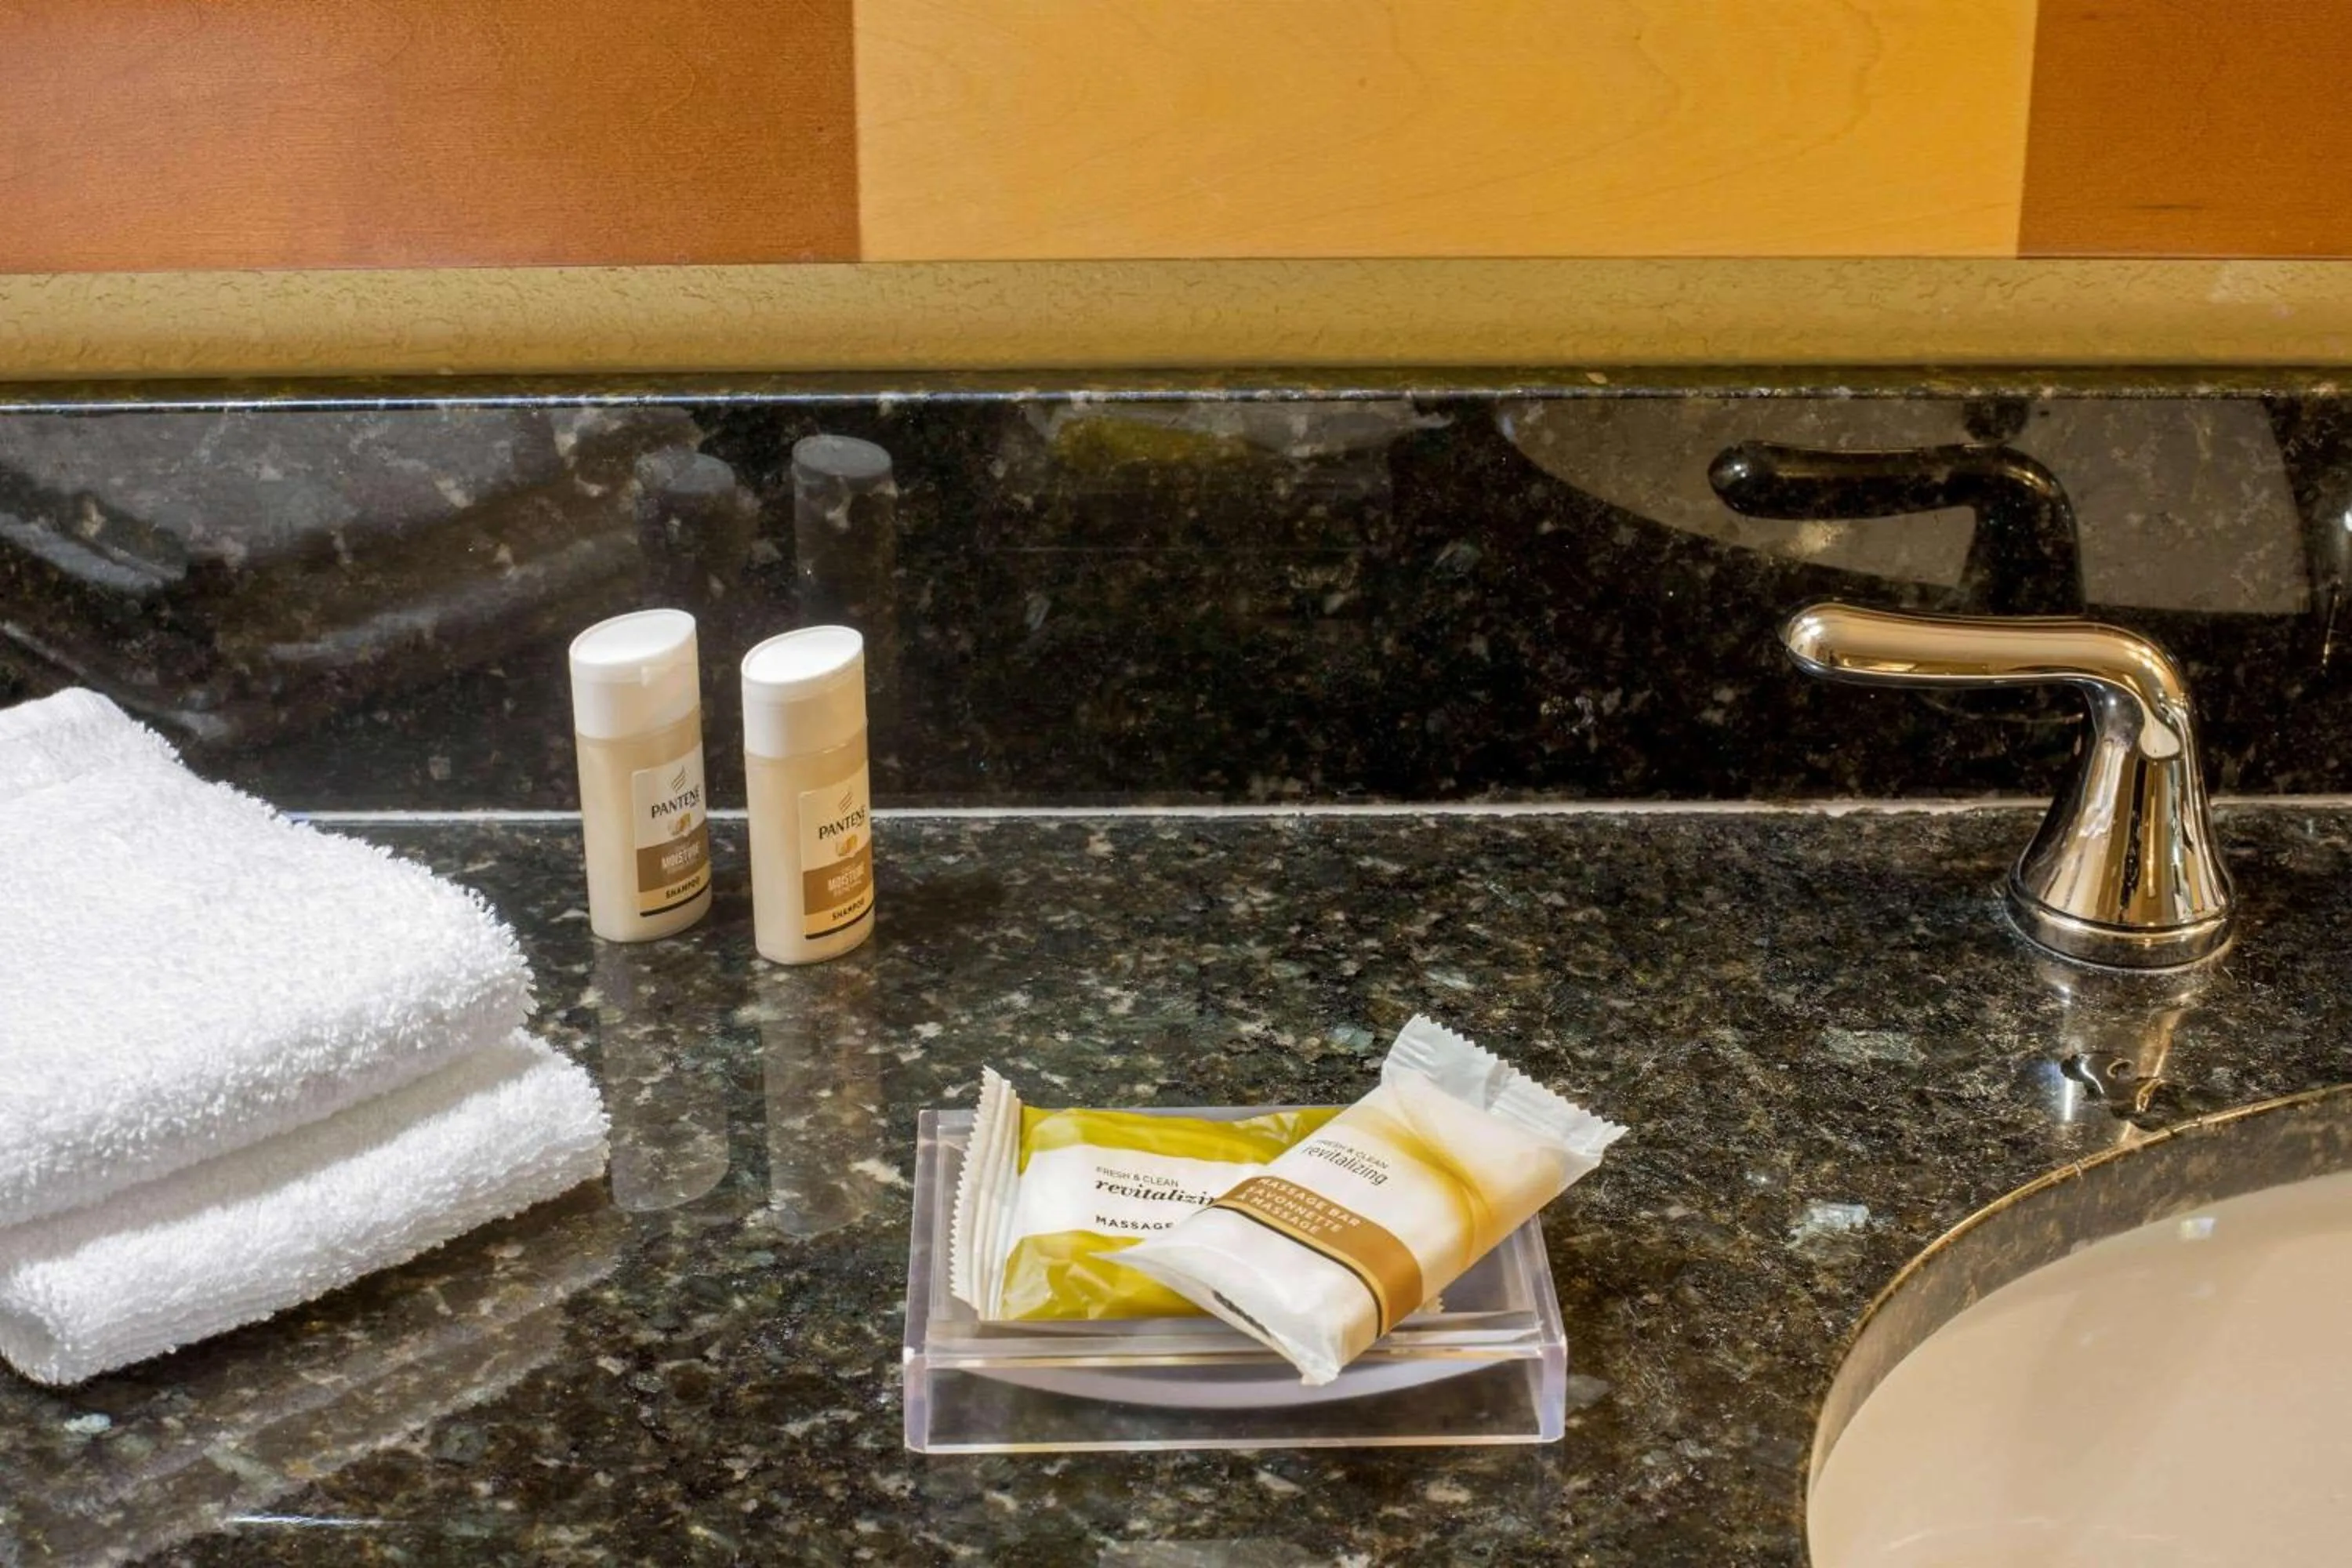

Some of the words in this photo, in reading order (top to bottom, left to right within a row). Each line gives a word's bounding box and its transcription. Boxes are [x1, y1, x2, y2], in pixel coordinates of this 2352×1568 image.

[1096, 1166, 1131, 1180] FRESH
[1142, 1176, 1179, 1188] CLEAN
[1301, 1145, 1388, 1185] revitalizing
[1356, 1150, 1389, 1170] CLEAN
[1245, 1186, 1343, 1232] SAVONNETTE
[1250, 1197, 1322, 1234] MASSAGE
[1257, 1178, 1326, 1211] MASSAGE
[1329, 1207, 1361, 1228] BAR
